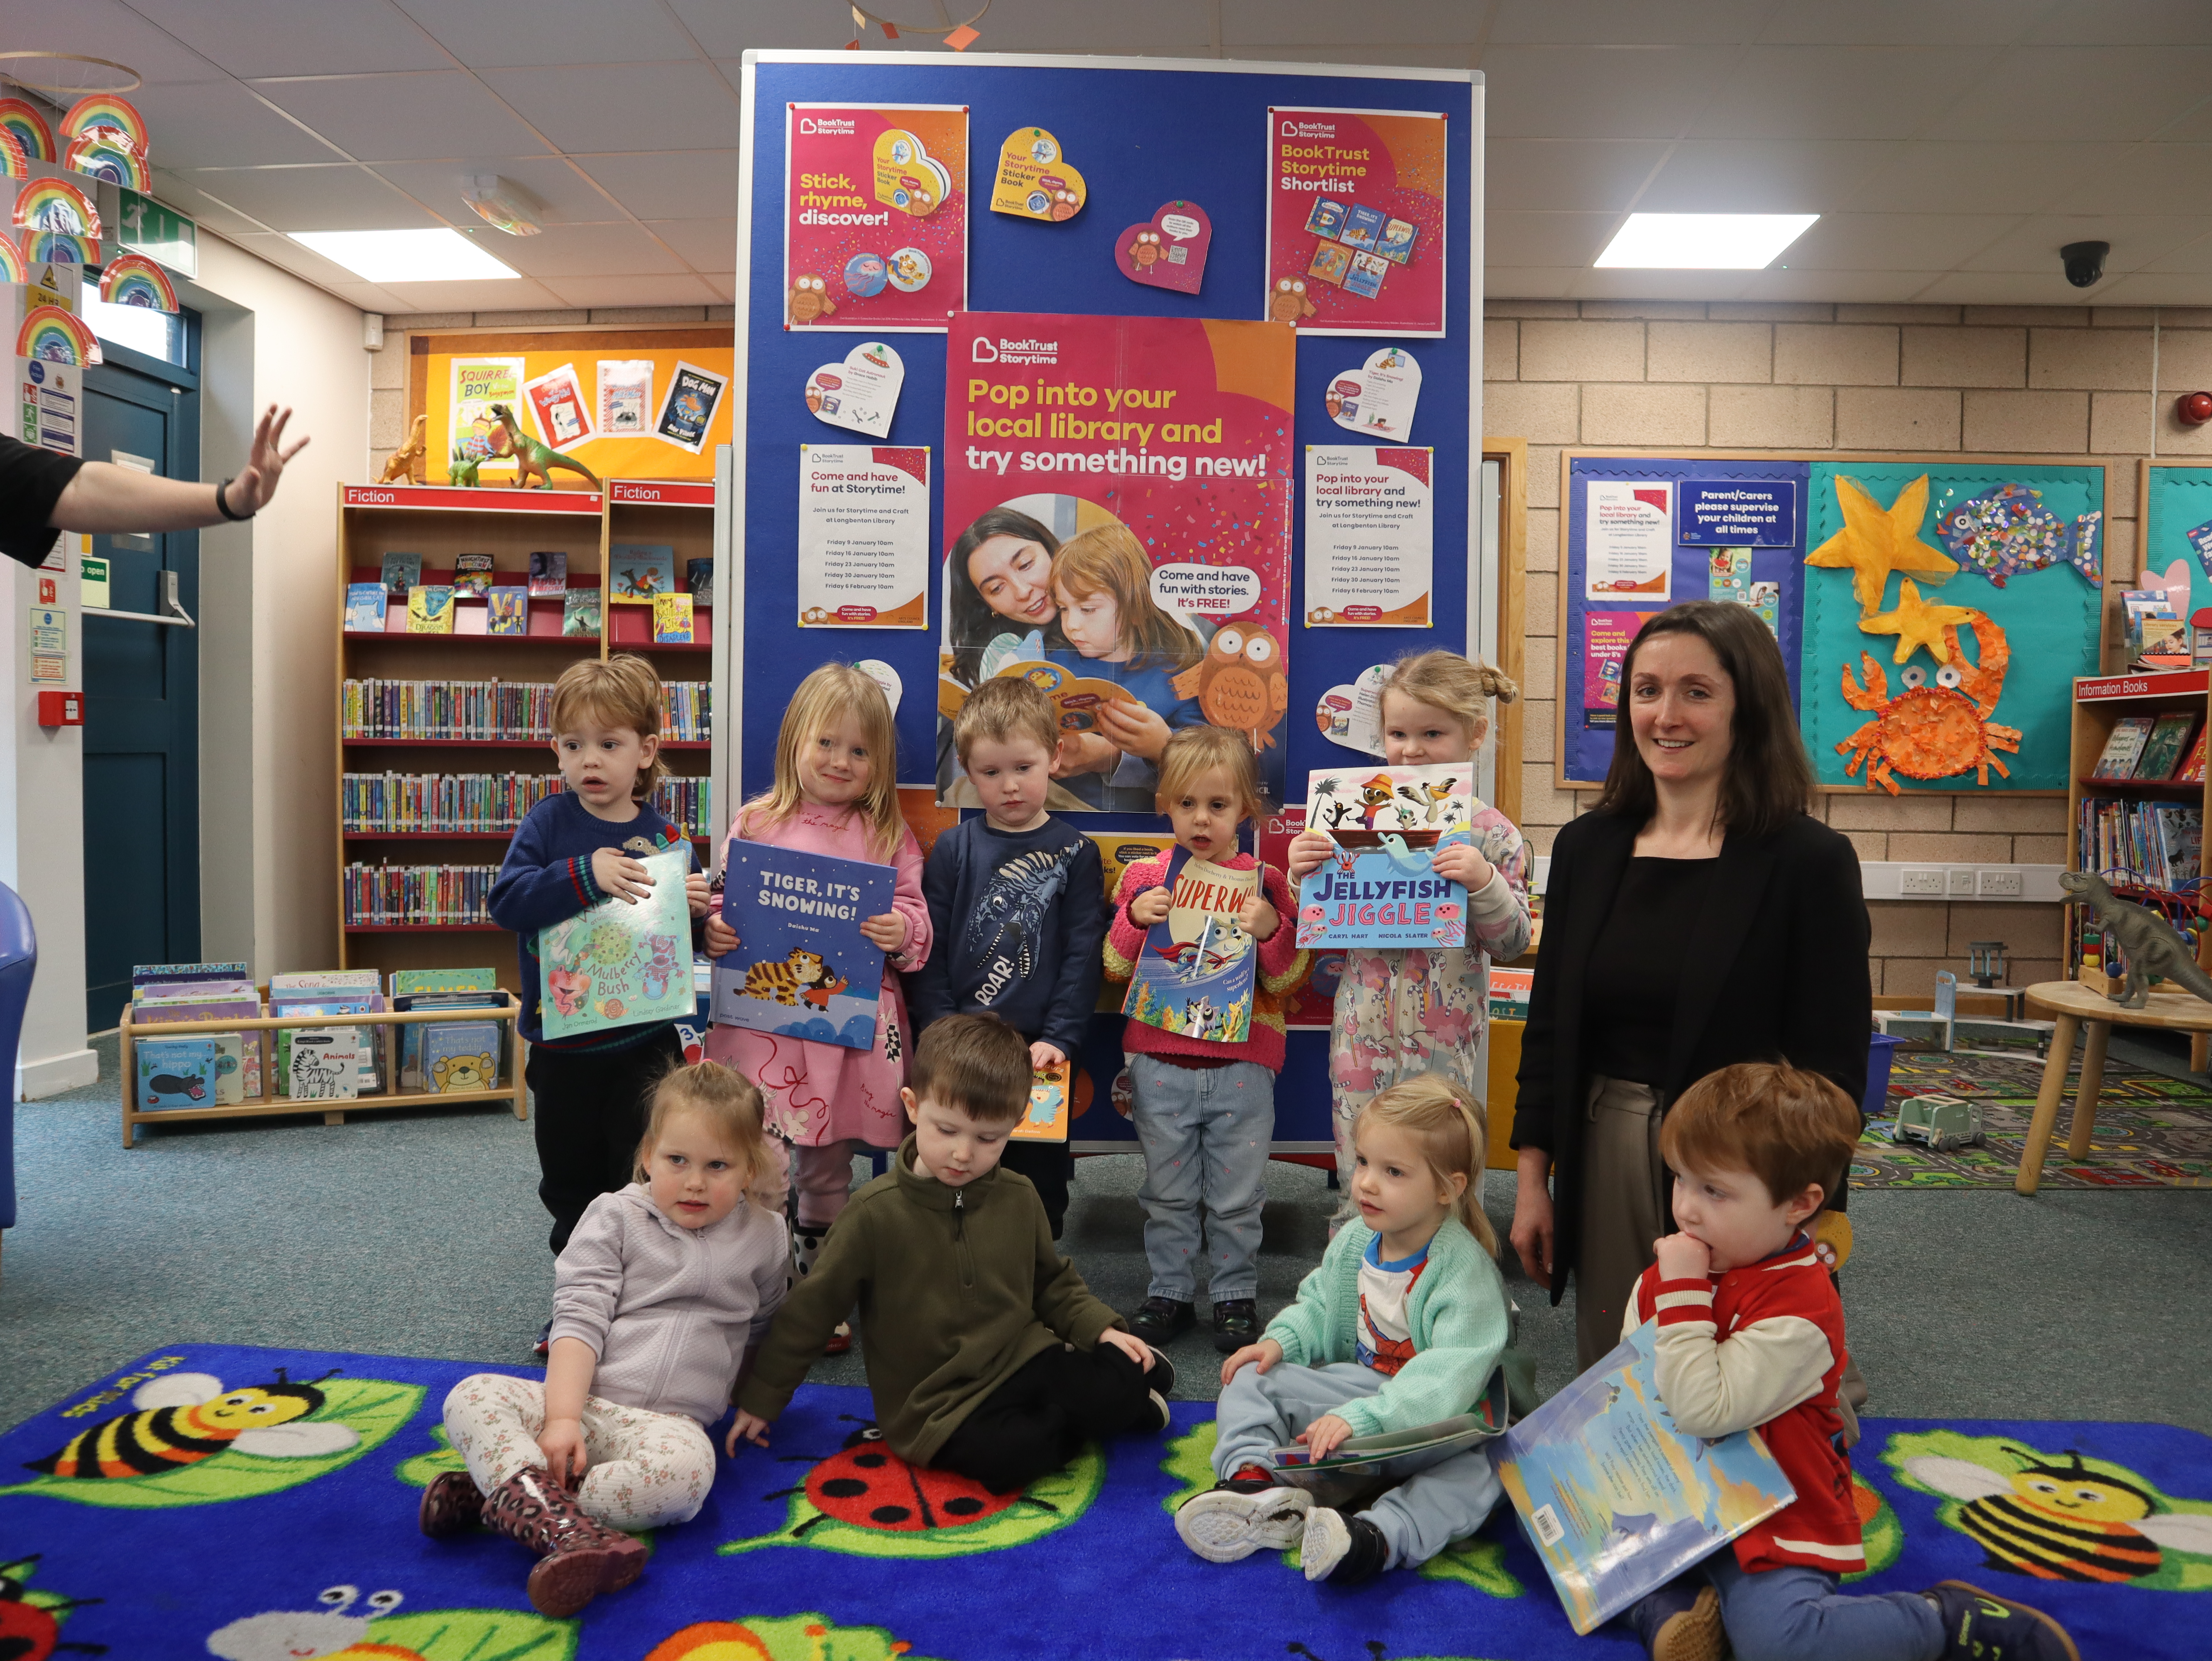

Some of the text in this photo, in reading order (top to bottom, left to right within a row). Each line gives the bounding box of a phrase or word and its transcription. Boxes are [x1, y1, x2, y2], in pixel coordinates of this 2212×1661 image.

[1007, 152, 1027, 162] Your
[1282, 145, 1370, 160] BookTrust
[876, 157, 890, 165] Your
[877, 164, 907, 175] Storytime
[1005, 160, 1050, 175] Storytime
[1282, 161, 1367, 177] Storytime
[877, 171, 897, 181] Sticker
[1003, 169, 1035, 181] Sticker
[800, 174, 856, 191] Stick,
[877, 178, 890, 186] Book
[1001, 177, 1023, 188] Book
[1281, 177, 1355, 192] Shortlist
[800, 191, 868, 209] rhyme,
[799, 210, 888, 225] discover!
[38, 293, 59, 306] 24 HR
[1000, 338, 1057, 352] BookTrust
[1000, 353, 1057, 365] Storytime
[465, 382, 490, 397] BOY
[682, 376, 716, 396] DOG MAN
[968, 378, 1176, 412] Pop into your
[967, 411, 1222, 446] local library and
[966, 446, 1265, 481] try something new!
[811, 471, 898, 481] Come and have
[1316, 474, 1389, 485] Pop into your
[614, 486, 660, 500] Fiction
[811, 483, 829, 492] fun
[847, 484, 905, 495] Storytime!
[1316, 486, 1405, 497] local library and
[348, 490, 394, 503] Fiction
[1701, 490, 1772, 501] Parent/Carers
[1316, 499, 1420, 509] try something new!
[1695, 503, 1779, 512] please supervise
[1698, 515, 1721, 524] your
[1723, 514, 1764, 522] children
[1715, 525, 1758, 534] all times
[1159, 570, 1250, 582] Come and have
[1160, 583, 1249, 595] fun with stories.
[1178, 598, 1230, 608] It's FREE!
[2078, 680, 2148, 697] Information Books
[1204, 867, 1222, 879] Docherty
[760, 870, 860, 901] TIGER, IT'S
[1313, 873, 1451, 902] JELLYFISH
[758, 890, 856, 921] SNOWING!
[1329, 903, 1431, 926] JIGGLE
[788, 923, 808, 931] Daishu
[587, 952, 641, 980] Mulberry
[974, 955, 1015, 1006] ROAR!
[598, 980, 629, 996] Bush
[633, 1004, 680, 1017] Lindsey Gardiner
[574, 1017, 597, 1026] Ormerod
[680, 1028, 693, 1040] 3
[162, 1059, 191, 1071] hippo
